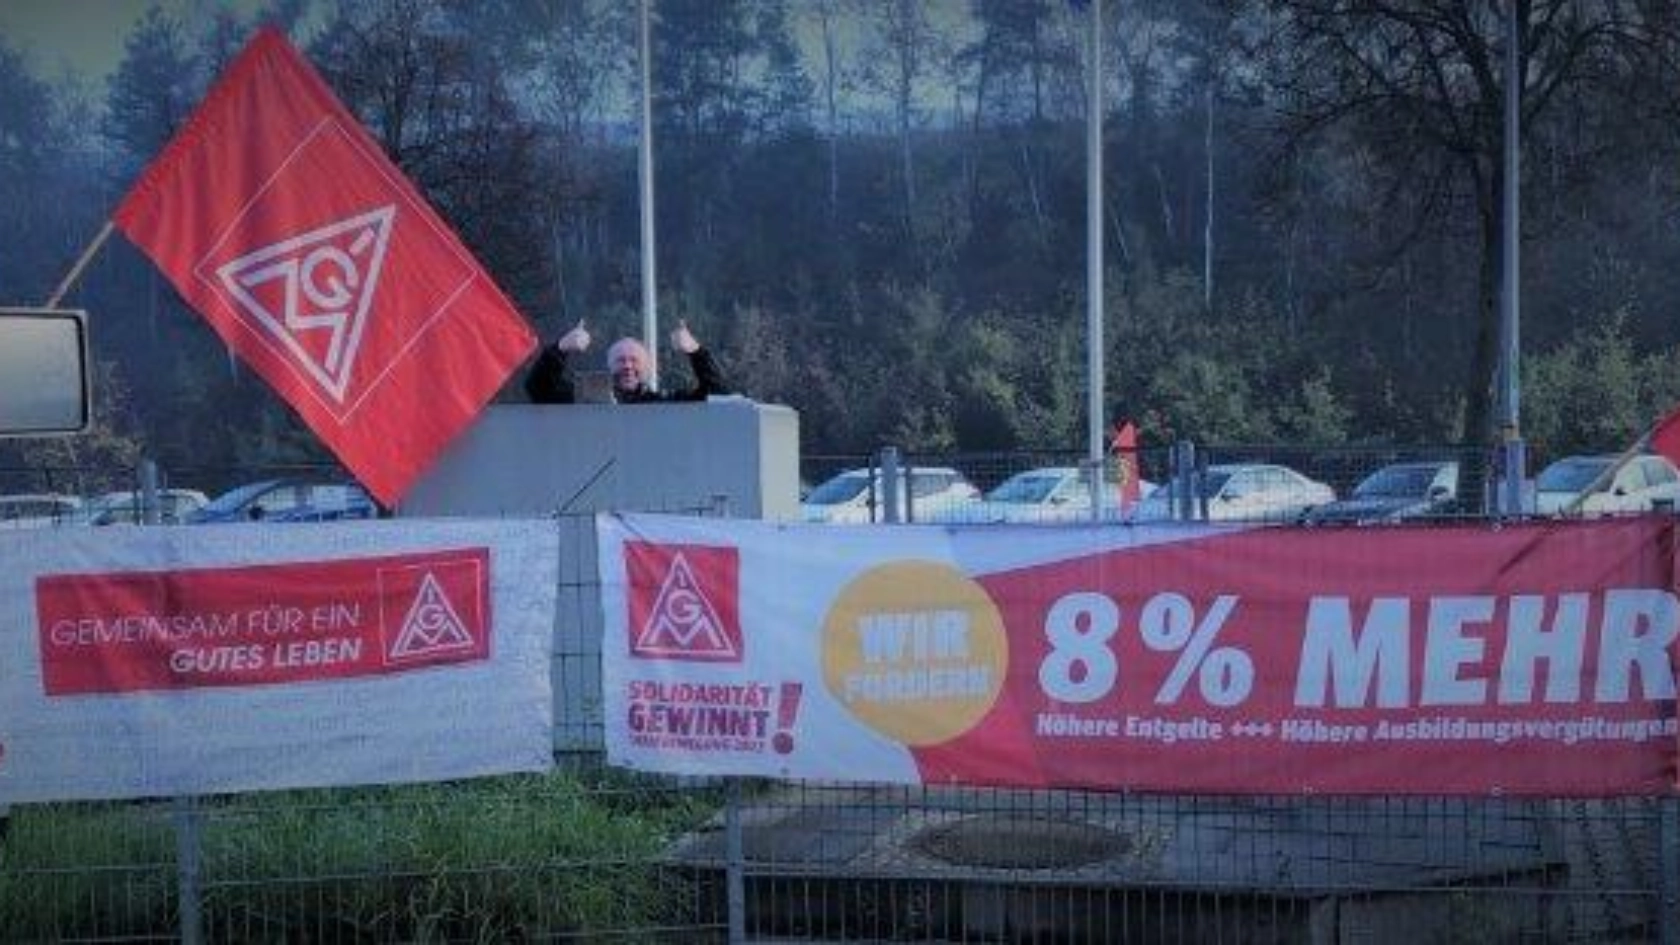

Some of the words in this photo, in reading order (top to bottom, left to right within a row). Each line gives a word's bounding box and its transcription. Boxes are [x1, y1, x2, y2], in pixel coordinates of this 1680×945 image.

[51, 612, 238, 645] GEMEINSAM
[248, 604, 304, 636] FÜR
[312, 602, 360, 631] EIN
[858, 609, 969, 663] WIR
[169, 643, 264, 673] GUTES
[273, 637, 363, 668] LEBEN
[1293, 588, 1680, 709] MEHR
[628, 680, 773, 708] SOLIDARITÄT
[1036, 713, 1119, 737] Höhere
[1125, 715, 1223, 742] Entgelte
[1281, 718, 1368, 743] Höhere
